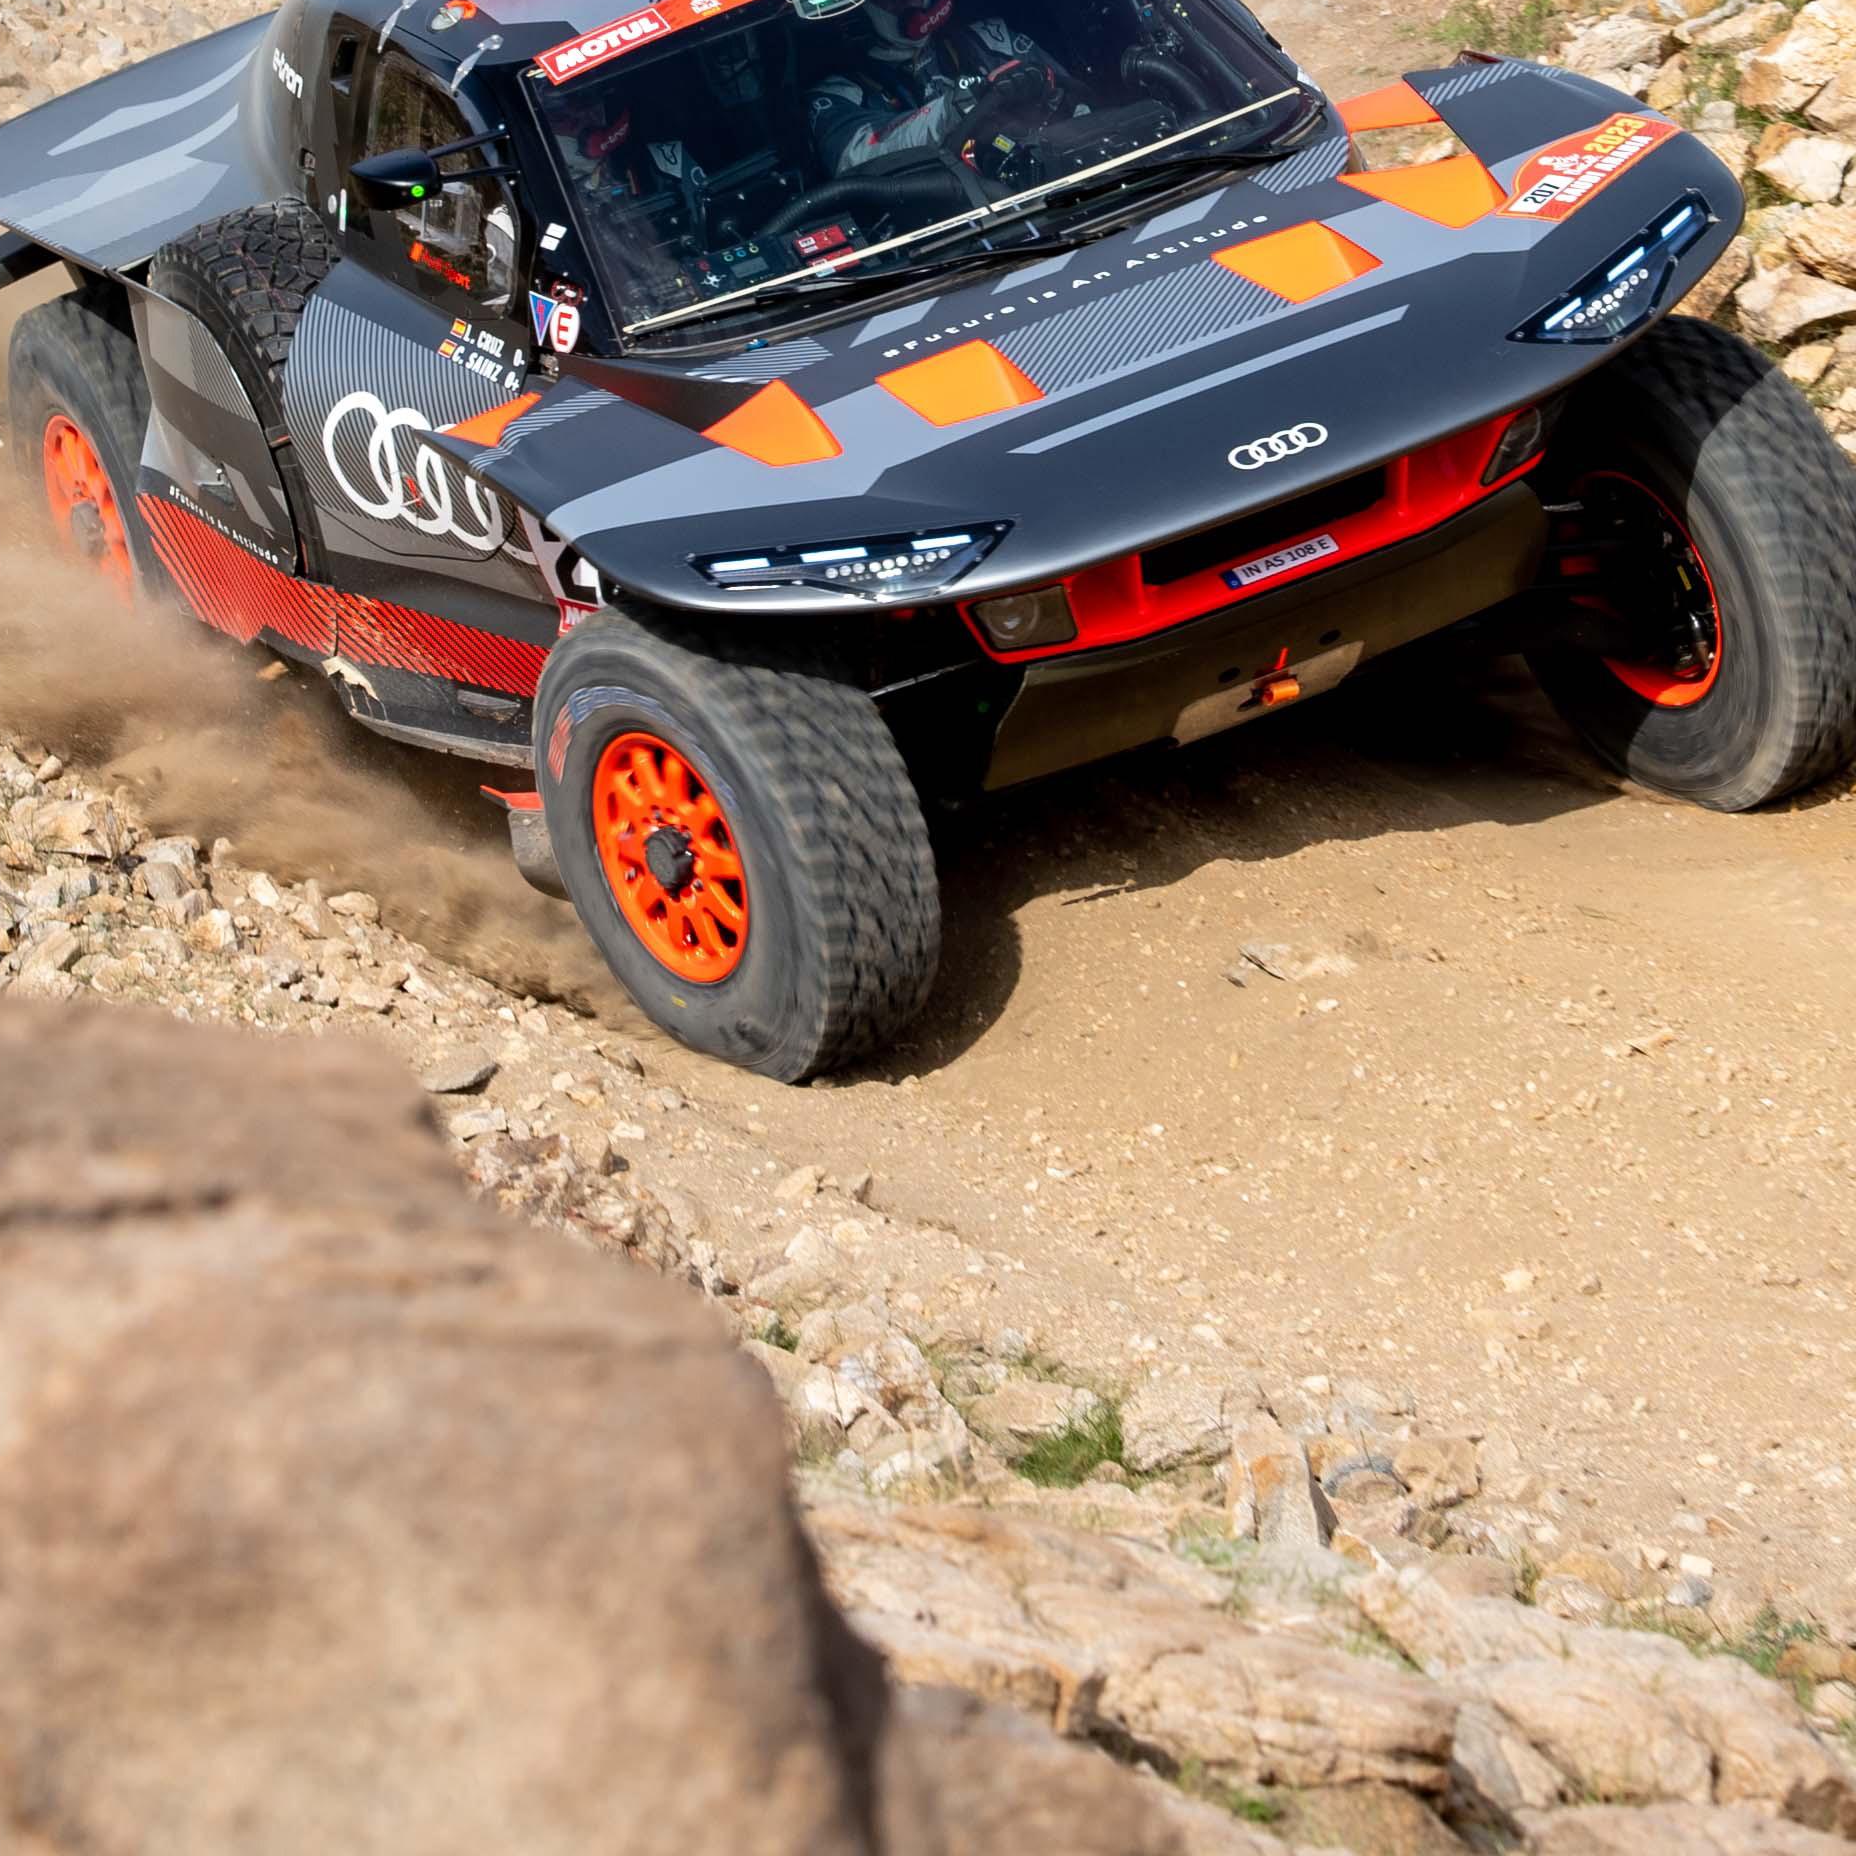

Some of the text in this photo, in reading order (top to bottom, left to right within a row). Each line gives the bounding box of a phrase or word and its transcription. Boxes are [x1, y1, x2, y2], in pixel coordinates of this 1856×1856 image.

[554, 17, 660, 73] MOTUL
[272, 47, 304, 99] e-tron
[1584, 117, 1647, 154] 2023
[1523, 182, 1560, 205] 207
[881, 305, 1016, 358] #Future
[1071, 270, 1112, 289] An
[1126, 214, 1269, 270] Attitude
[462, 323, 475, 345] L.
[476, 330, 505, 358] CRUZ
[557, 312, 572, 345] E
[451, 347, 464, 366] C.
[465, 352, 504, 383] SAINZ
[1242, 539, 1330, 578] IN AS 108 E
